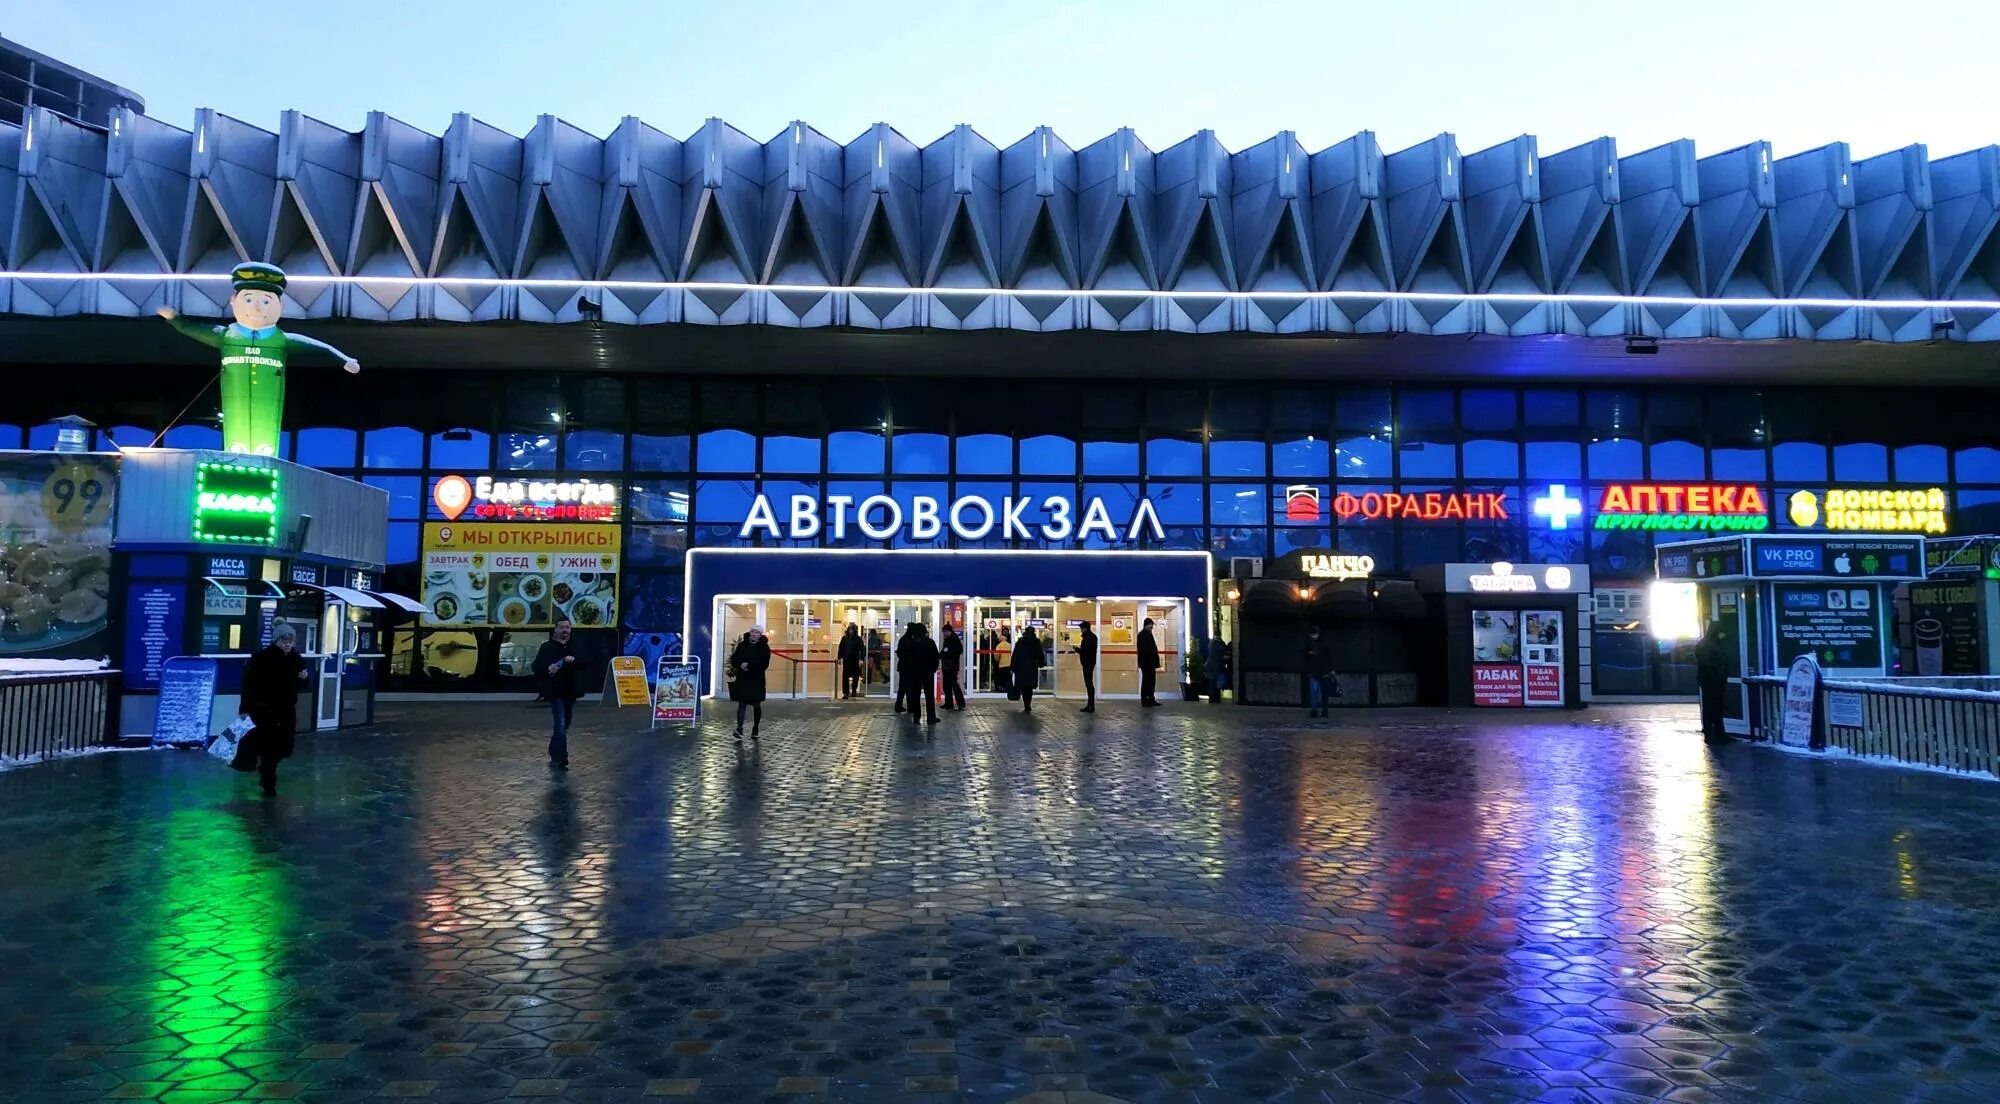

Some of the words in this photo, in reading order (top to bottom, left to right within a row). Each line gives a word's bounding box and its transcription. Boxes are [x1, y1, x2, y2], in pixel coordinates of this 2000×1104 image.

[53, 478, 103, 514] 99
[475, 476, 524, 503] Еда
[528, 481, 616, 505] всегда
[197, 492, 276, 513] КАССА
[1333, 491, 1509, 520] ФОРАБАНК
[1600, 485, 1767, 513] АПТЕКА
[1824, 487, 1946, 511] ДОНСКОЙ
[739, 494, 1167, 541] АВТОВОКЗАЛ
[1594, 513, 1768, 532] КРУГЛОСУТОЧНО
[1825, 510, 1946, 533] ЛОМБАРД
[463, 530, 492, 545] МЫ
[498, 531, 613, 546] ОТКРЫЛИСЬ!
[429, 556, 469, 564] ЗАВТРАК
[472, 556, 484, 564] 79
[496, 557, 529, 569] ОБЕД
[559, 557, 597, 568] УЖИН
[1764, 550, 1783, 561] VK
[1786, 549, 1815, 561] PRO
[211, 558, 245, 569] КАССА
[1301, 555, 1375, 573] ПАНЧО
[211, 569, 245, 577] БИЛЕТНАЯ
[292, 570, 316, 584] касса
[206, 598, 242, 608] КАССА
[1801, 593, 1820, 601] PRO
[1475, 669, 1519, 680] ТАБАК
